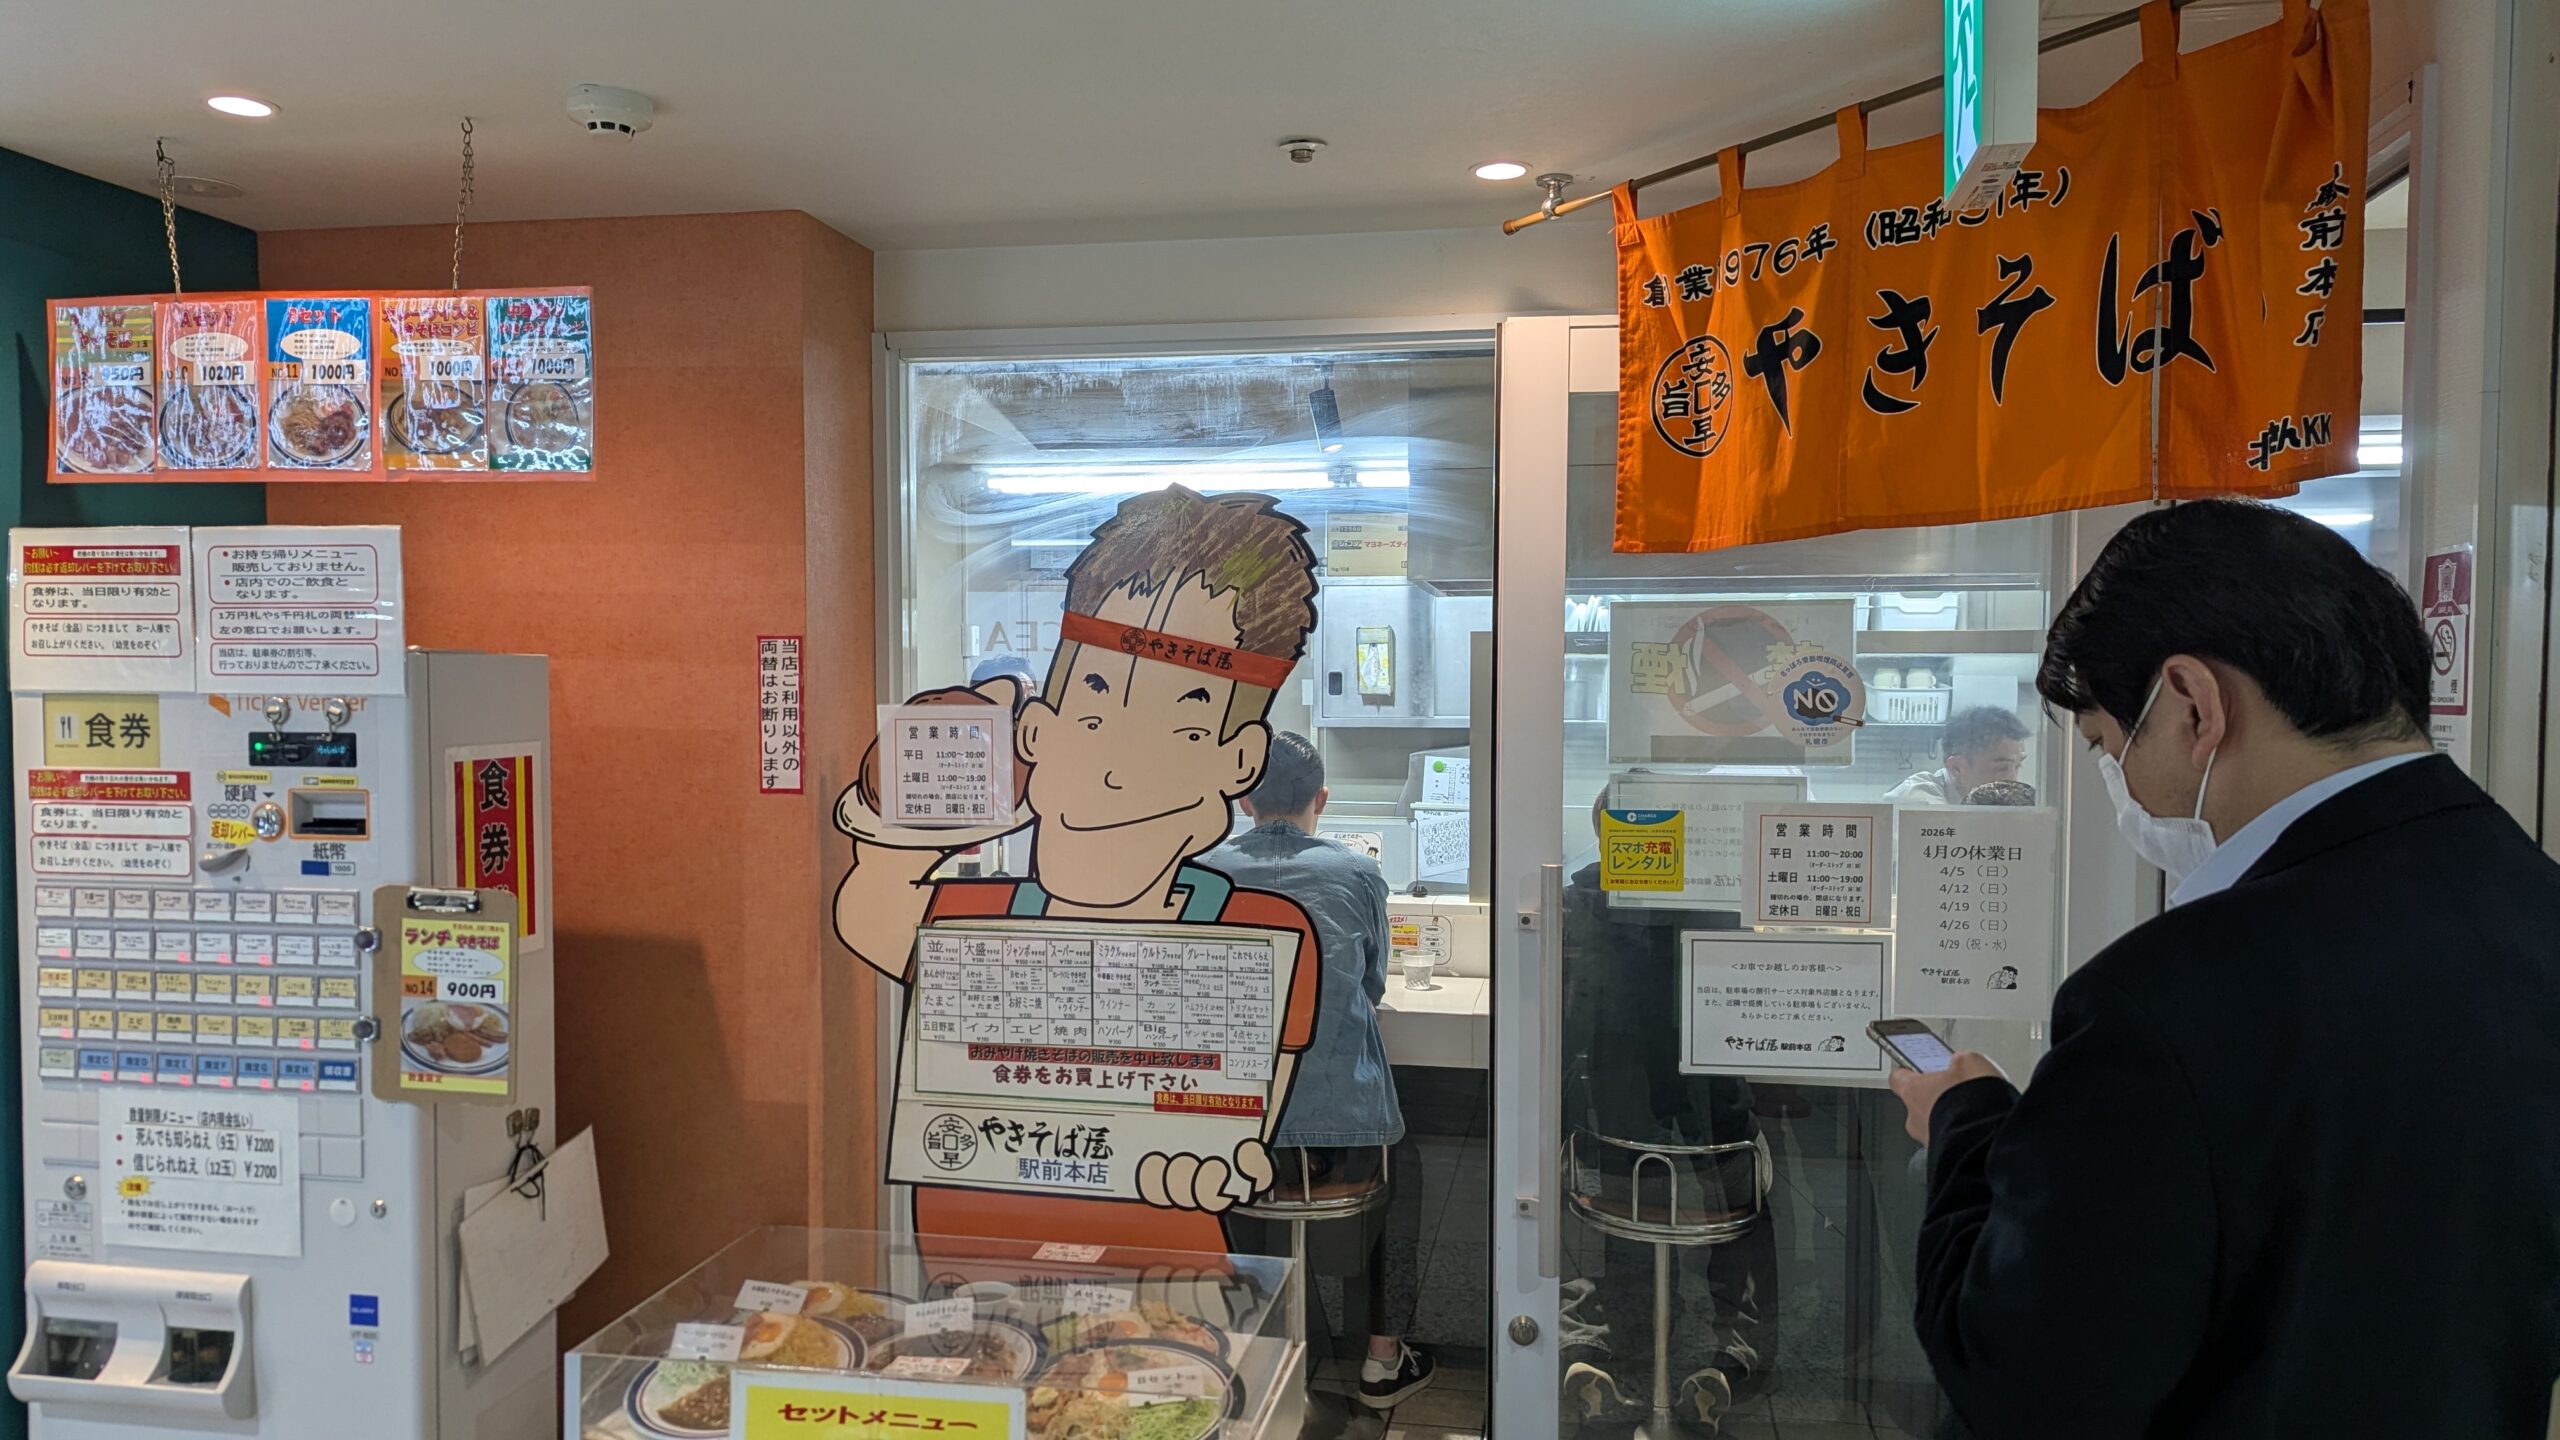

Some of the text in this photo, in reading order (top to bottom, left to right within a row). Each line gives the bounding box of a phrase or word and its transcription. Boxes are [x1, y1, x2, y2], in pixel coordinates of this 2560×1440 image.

[1742, 207, 2225, 438] やきそば
[202, 363, 245, 381] 1020円
[311, 363, 355, 380] 1000円
[430, 359, 473, 377] 1000円
[232, 549, 357, 560] お持ち帰りメニュー
[231, 562, 365, 573] 販売しておりません。
[235, 577, 349, 588] 店内でのご飲食と
[32, 586, 171, 597] 食券は、当日限り有効と
[236, 590, 298, 600] なります。
[32, 599, 88, 608] なります。
[218, 625, 361, 635] 左の窓口でお願いします。
[218, 660, 370, 671] 行っておりませんのでご了承ください。
[782, 640, 800, 771] 当店ご利用以外の
[1793, 688, 1840, 713] NO
[761, 640, 779, 789] 両替はお断りします
[85, 712, 151, 749] 食券
[909, 726, 980, 739] 営業時間
[903, 749, 923, 760] 平日
[903, 772, 929, 783] 土曜日
[225, 784, 256, 802] 硬貨
[40, 808, 183, 819] 食券は、当日限り有効と
[905, 804, 985, 814] 定休日 日曜日・祝日
[40, 820, 98, 829] なります。
[479, 758, 511, 890] 食券
[211, 821, 257, 840] 返却レバー
[1776, 823, 1857, 838] 営業時間
[1921, 827, 1956, 837] 2026年
[313, 843, 346, 860] 紙幣
[1611, 841, 1672, 855] スマホ充電
[1769, 848, 1792, 859] 平日
[1923, 845, 2022, 861] 4月の休業日
[1612, 856, 1672, 870] レンタル
[1940, 865, 1965, 876] 4/5
[1768, 872, 1798, 883] 土曜日
[1939, 883, 1969, 894] 4/12
[1769, 905, 1861, 917] 定休日 日曜日・祝日
[1939, 901, 1970, 912] 4/19
[1939, 919, 1970, 930] 4/26
[405, 928, 451, 946] ランチ
[456, 934, 500, 950] やきそば
[1939, 938, 1960, 949] 4/29
[447, 982, 496, 999] 900円
[925, 995, 956, 1007] たまご
[1741, 1012, 1833, 1022] あらかじめご了承ください。
[965, 1023, 1000, 1033] イカ
[1010, 1024, 1043, 1035] エビ
[1724, 1036, 1778, 1051] やきそば屋
[993, 1064, 1198, 1091] 食券をお買上げ下さい
[136, 1128, 211, 1150] 死んでも知らねえ
[978, 1116, 1113, 1160] やきそば屋
[133, 1154, 199, 1175] 信じられねえ
[1018, 1157, 1109, 1184] 駅前本店
[778, 1403, 977, 1429] セットメニュー
